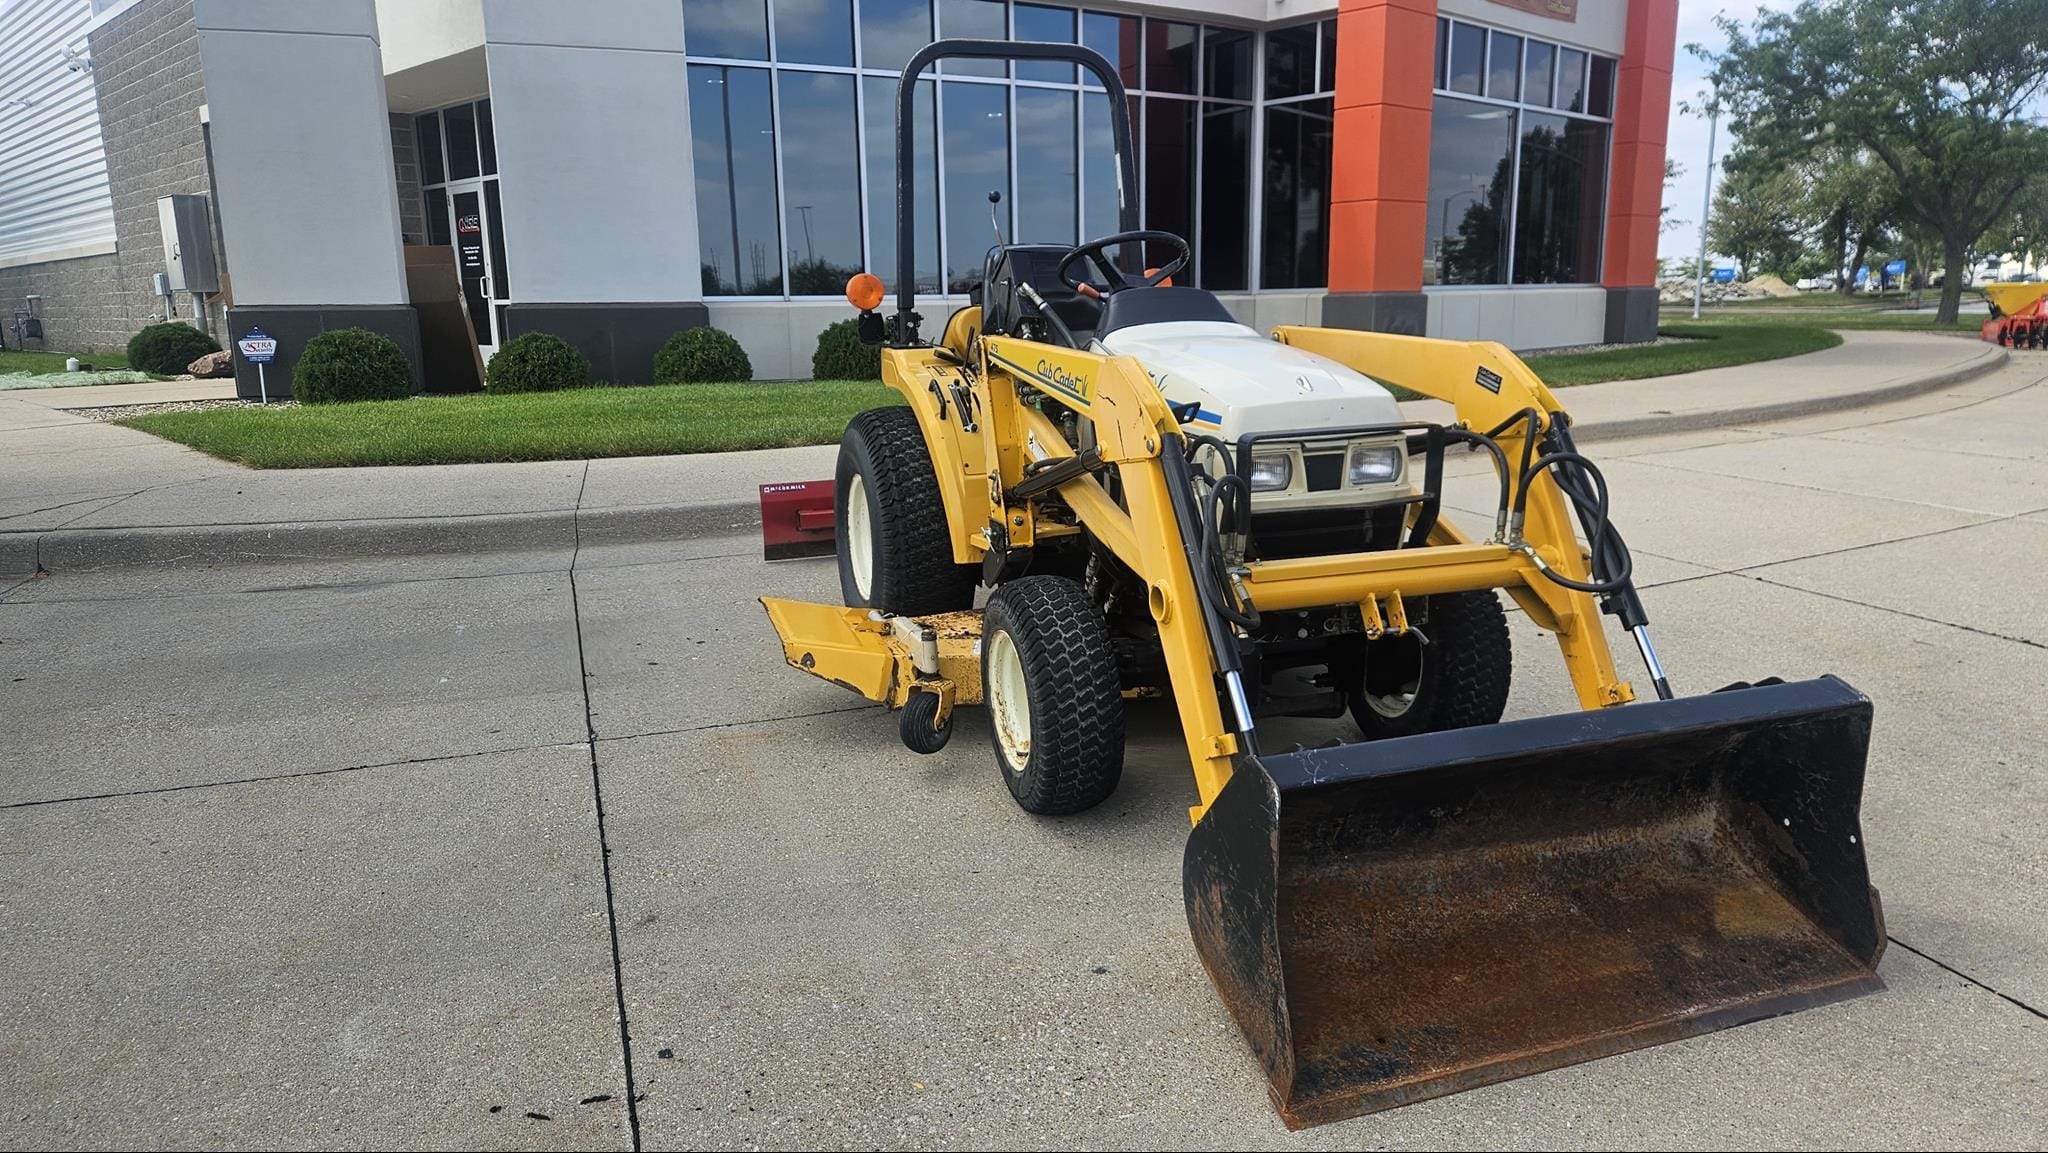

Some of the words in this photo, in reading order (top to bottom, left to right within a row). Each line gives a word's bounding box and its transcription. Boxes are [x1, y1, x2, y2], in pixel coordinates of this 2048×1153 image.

[245, 342, 272, 352] ASTRA
[1037, 359, 1052, 380] Cub
[1053, 367, 1082, 393] Cadet
